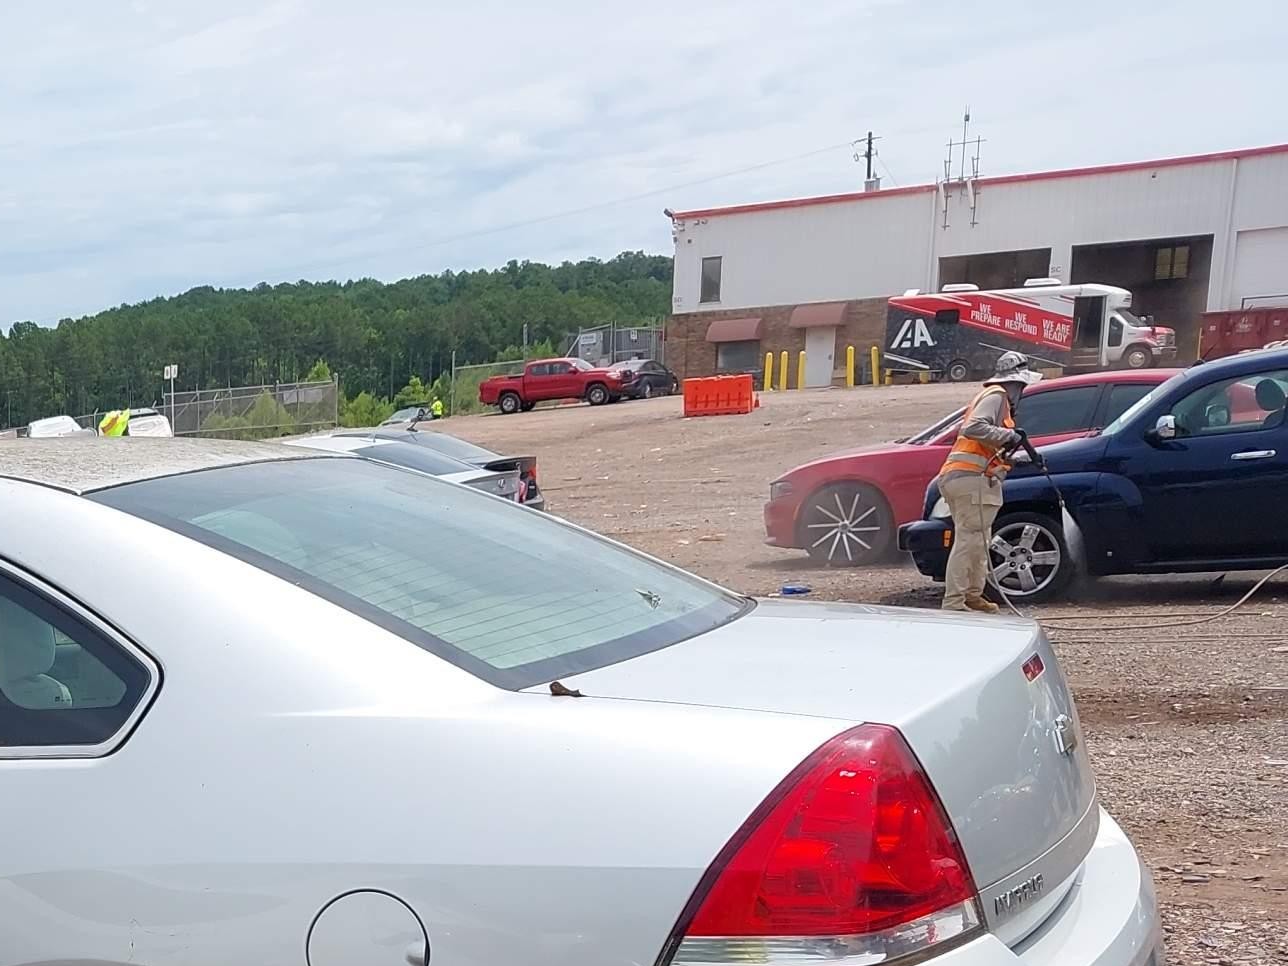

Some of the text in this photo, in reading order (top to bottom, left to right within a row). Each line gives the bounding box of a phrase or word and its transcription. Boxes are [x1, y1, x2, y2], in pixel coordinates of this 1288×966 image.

[979, 302, 992, 314] WE
[970, 309, 1002, 327] PREPARE
[1014, 311, 1028, 324] WE
[1004, 318, 1038, 336] RESPOND
[1042, 319, 1071, 336] WE ARE
[1043, 329, 1069, 343] READY
